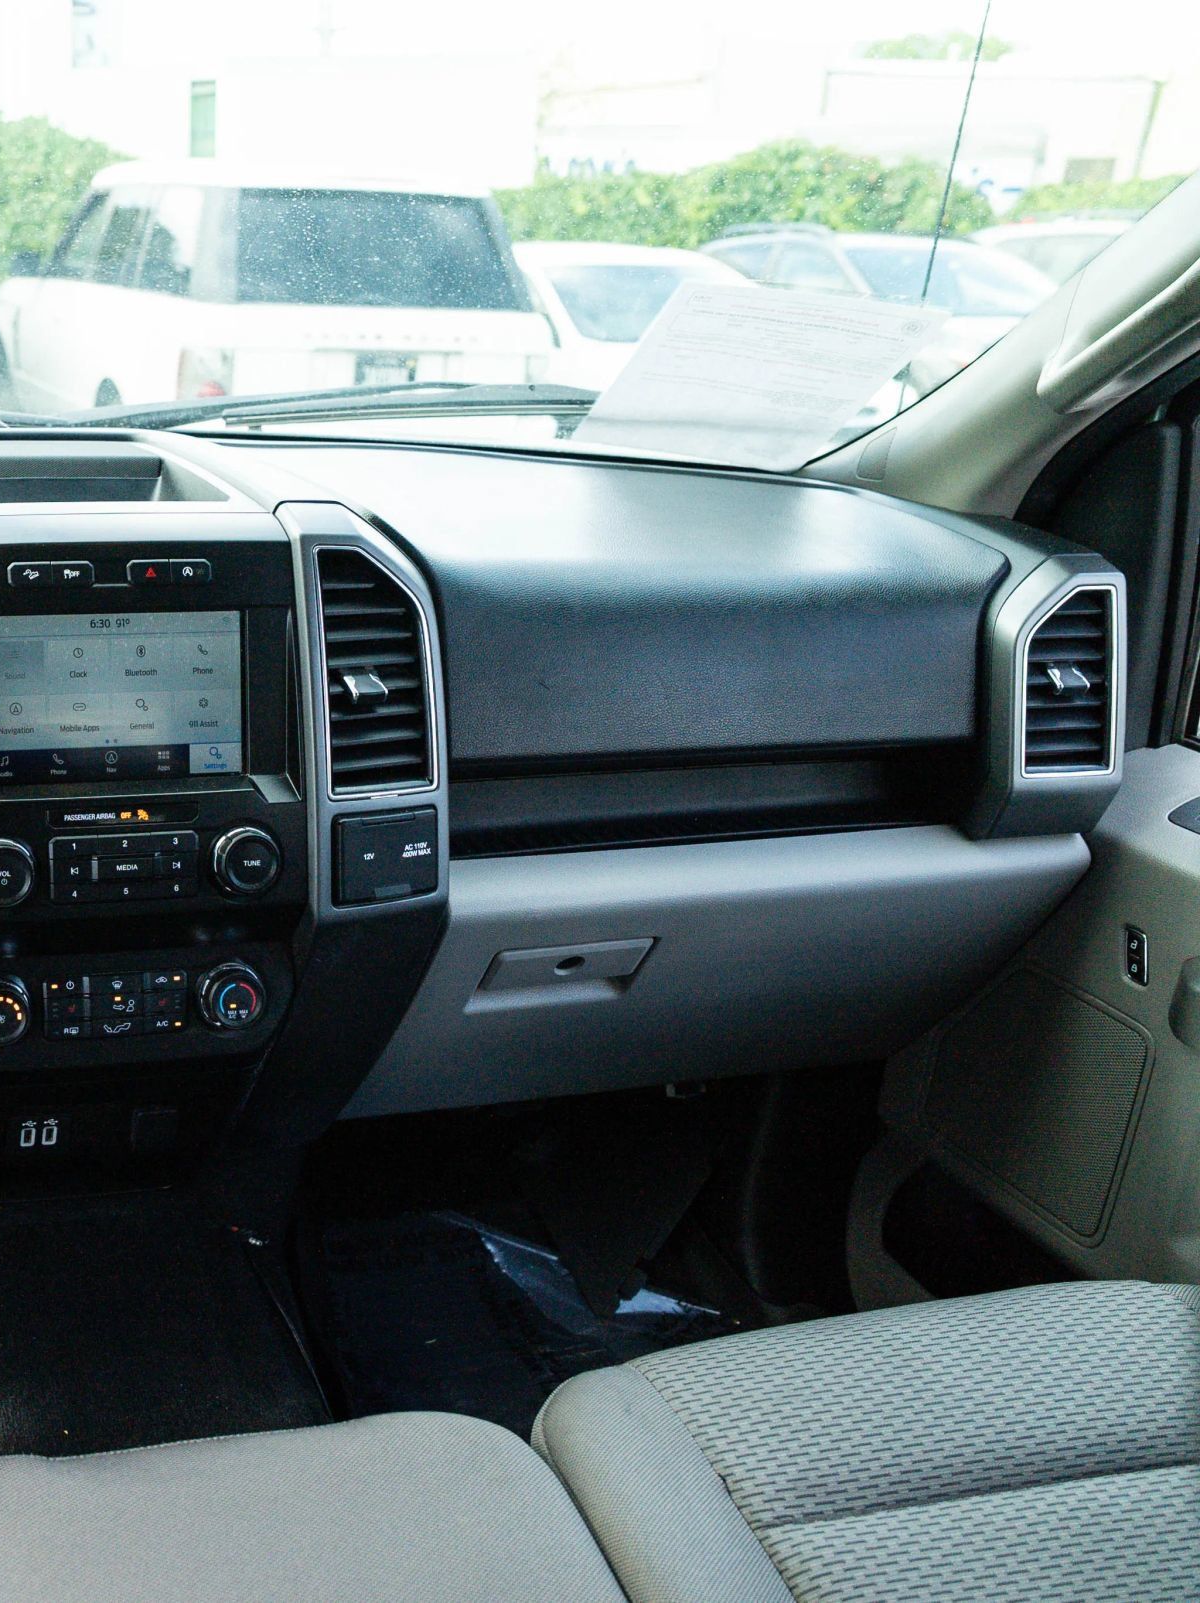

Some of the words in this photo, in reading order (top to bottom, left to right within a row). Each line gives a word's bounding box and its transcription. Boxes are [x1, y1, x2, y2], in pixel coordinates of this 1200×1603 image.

[89, 619, 111, 629] 6:30
[69, 670, 88, 679] Clock
[124, 668, 158, 677] Bluetooth
[192, 667, 214, 675] Phone
[129, 722, 155, 730] General
[189, 720, 199, 728] 911
[199, 720, 219, 728] Assist
[59, 724, 81, 732] Mobile
[83, 724, 100, 733] Apps
[63, 813, 96, 822] PASSENGER
[96, 812, 116, 820] AIRBAG
[120, 811, 132, 819] OFF
[122, 840, 128, 848] 2
[173, 837, 179, 845] 3
[404, 843, 413, 851] AC
[418, 848, 431, 856] MAX
[363, 853, 375, 861] 12V
[243, 859, 261, 867] TUNE
[116, 863, 139, 872] MEDIA
[173, 884, 179, 892] 6
[71, 890, 77, 898] 4
[156, 1020, 169, 1028] A/C
